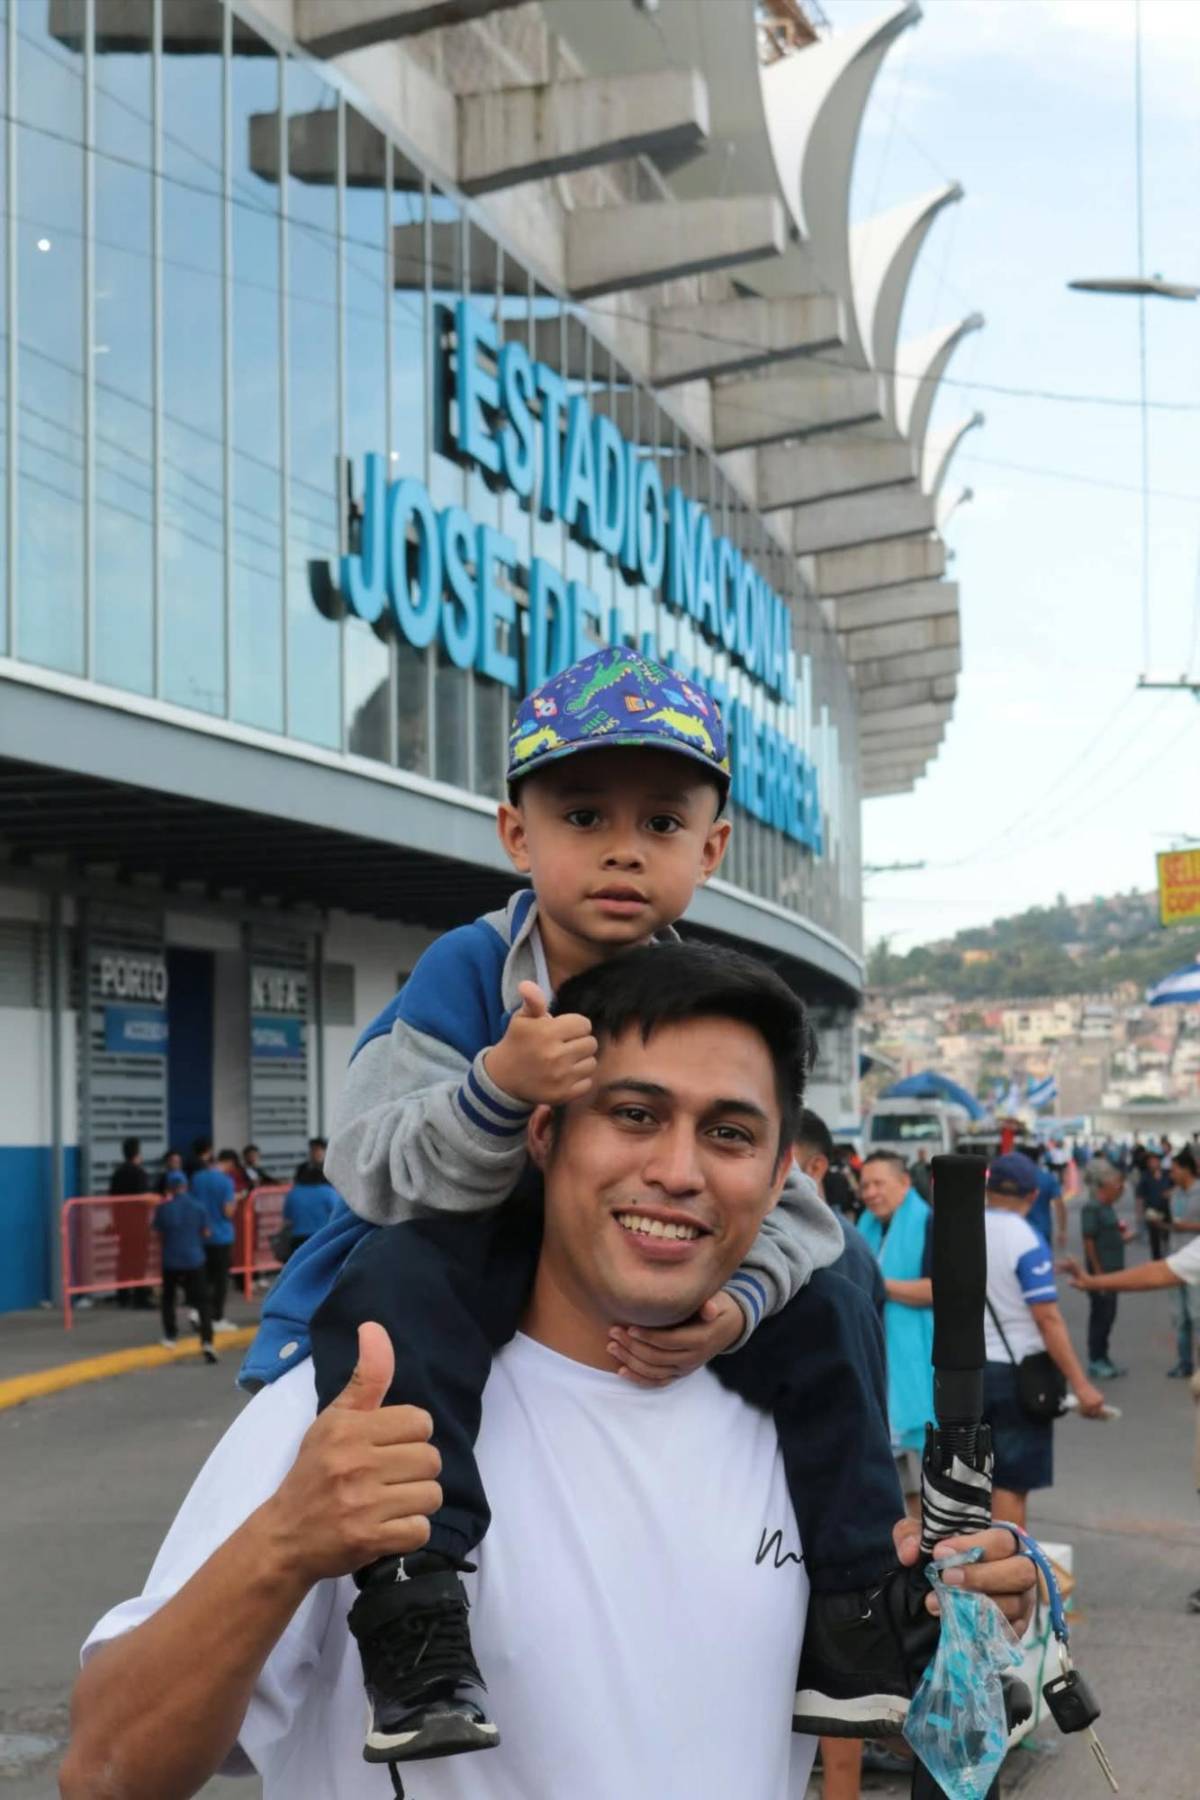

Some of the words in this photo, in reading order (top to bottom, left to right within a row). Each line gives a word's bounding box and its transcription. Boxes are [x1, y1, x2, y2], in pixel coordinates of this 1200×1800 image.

[341, 452, 520, 692] JOSE
[455, 300, 666, 592] ESTADIO
[668, 486, 795, 706] NACIONAL
